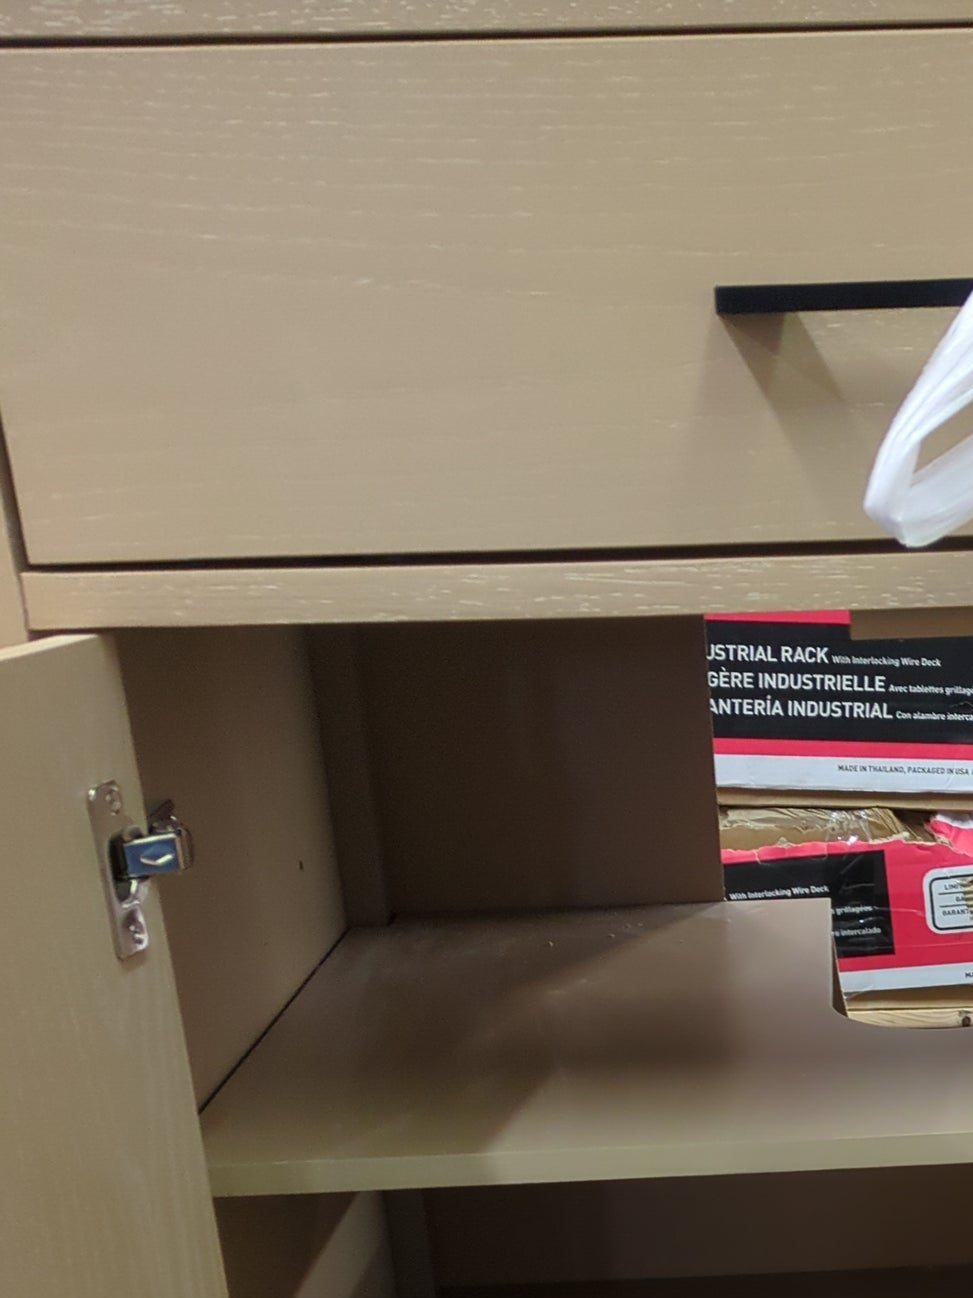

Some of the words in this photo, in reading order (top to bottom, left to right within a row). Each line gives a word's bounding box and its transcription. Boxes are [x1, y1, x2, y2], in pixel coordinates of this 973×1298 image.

[706, 644, 778, 661] USTRIAL
[780, 645, 829, 664] RACK
[831, 654, 851, 664] With
[852, 655, 900, 667] Interlocking
[900, 657, 920, 666] Wire
[921, 657, 942, 667] Deck
[707, 666, 754, 688] GÈRE
[758, 672, 886, 692] INDUSTRIELLE
[888, 684, 908, 693] Avec
[908, 684, 945, 695] tablettes
[709, 694, 784, 717] ANTERÍA
[787, 700, 893, 719] INDUSTRIAL
[895, 710, 912, 720] Con
[913, 711, 946, 721] alambre
[838, 764, 858, 773] MADE
[859, 765, 867, 773] IN
[868, 765, 906, 774] THAILAND,
[907, 766, 946, 775] PACKAGED
[946, 767, 954, 775] IN
[729, 892, 747, 900] With
[747, 888, 792, 898] Interlocking
[793, 886, 810, 895] Wire
[810, 885, 829, 894] Deck
